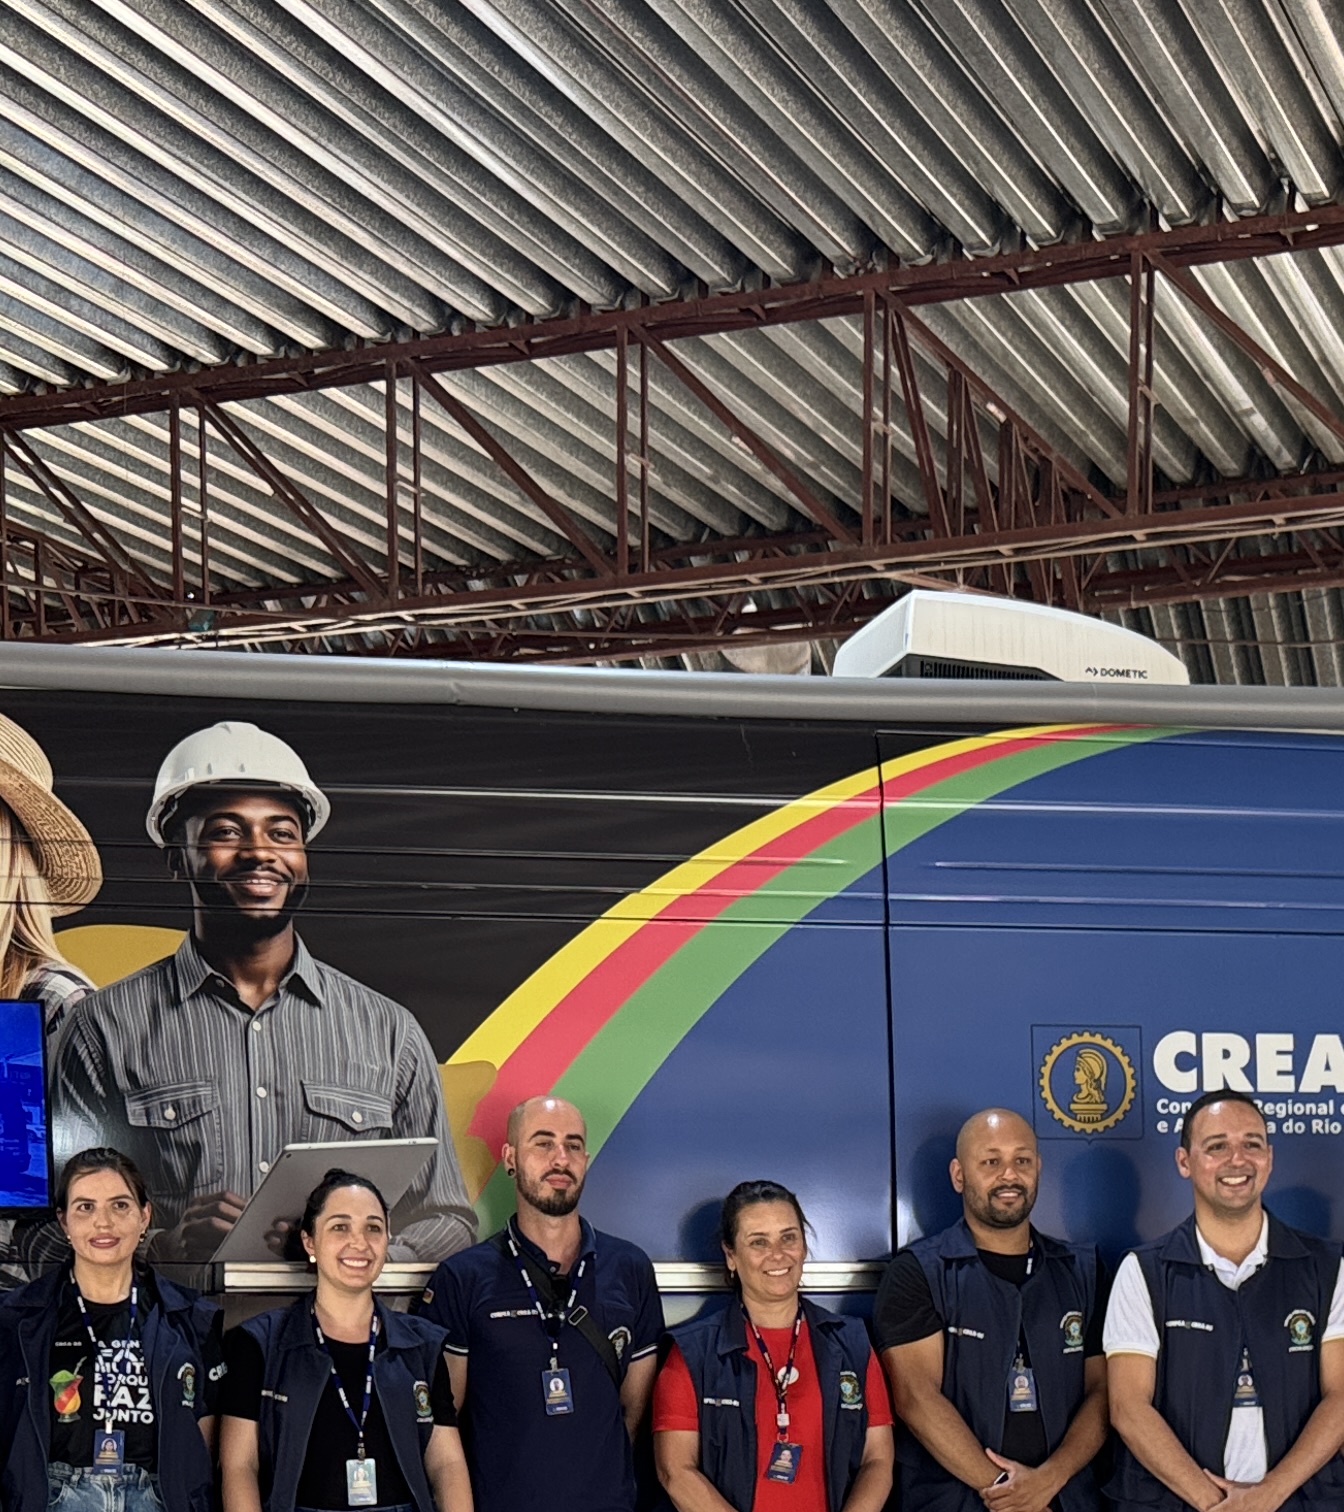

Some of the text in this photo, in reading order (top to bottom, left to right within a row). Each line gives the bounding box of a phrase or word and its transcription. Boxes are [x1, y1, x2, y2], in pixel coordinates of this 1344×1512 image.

[1100, 667, 1148, 680] DOMETIC
[1156, 1120, 1169, 1134] e
[1282, 1118, 1306, 1135] do
[1311, 1118, 1343, 1135] Rio
